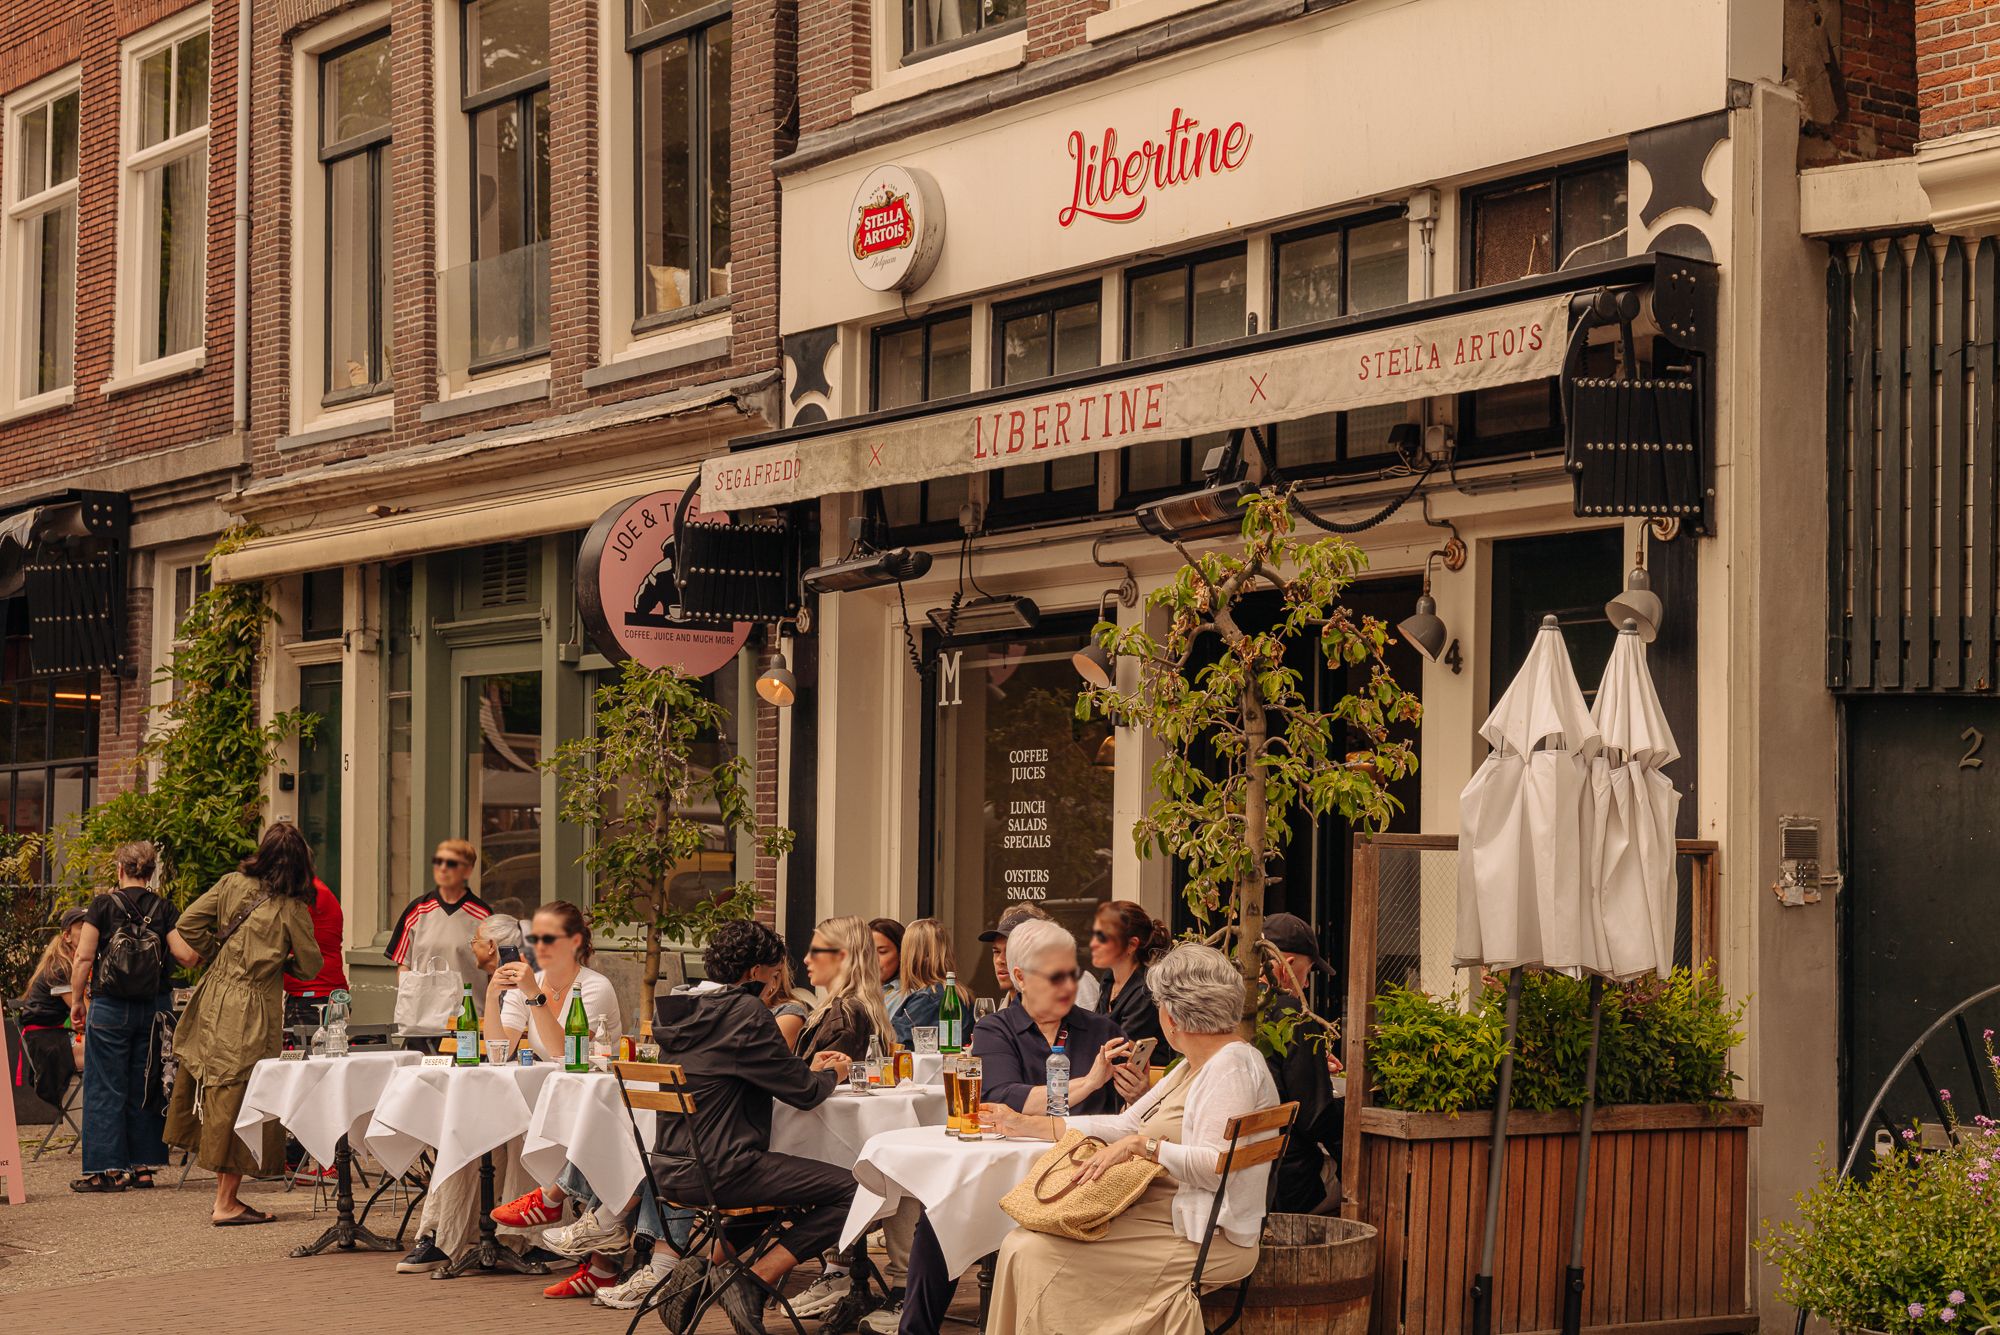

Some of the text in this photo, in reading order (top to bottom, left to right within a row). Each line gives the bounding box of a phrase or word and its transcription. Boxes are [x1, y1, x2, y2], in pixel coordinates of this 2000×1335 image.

[1058, 107, 1253, 227] Libertine
[864, 208, 904, 231] STELLA
[864, 222, 905, 247] ARTOIS
[714, 457, 800, 491] SEGAFREDO
[974, 383, 1164, 459] LIBERTINE
[1358, 342, 1441, 381] STELLA
[1453, 323, 1543, 366] ARTOIS
[612, 519, 643, 562] JOE
[641, 509, 658, 529] &
[624, 629, 735, 645] COFFEE, JUICE AND MUCH MORE
[1444, 638, 1463, 675] 4
[939, 651, 963, 706] M
[1958, 726, 1983, 768] 2
[344, 753, 349, 771] 5
[1009, 749, 1049, 764] COFFEE
[1011, 766, 1046, 783] JUICES
[1010, 800, 1046, 815] LUNCH
[1008, 817, 1047, 832] SALADS
[1003, 834, 1051, 849] SPECIALS
[1004, 869, 1050, 883] OYSTERS
[1007, 886, 1046, 900] SNACKS
